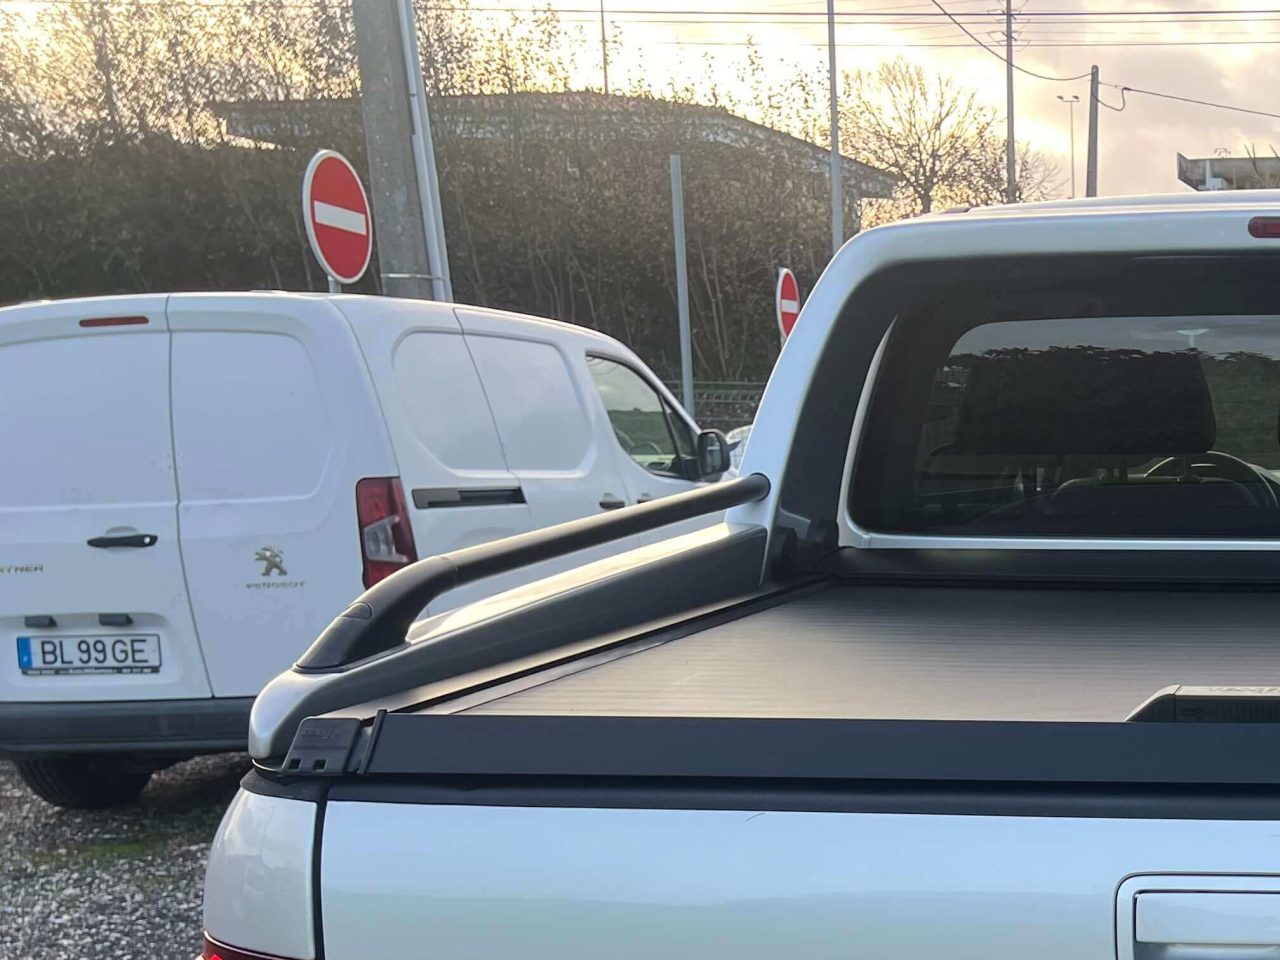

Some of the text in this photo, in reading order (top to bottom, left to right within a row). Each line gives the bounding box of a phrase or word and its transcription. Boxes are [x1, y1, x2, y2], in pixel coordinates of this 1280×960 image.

[41, 639, 149, 665] BL 99 GE
